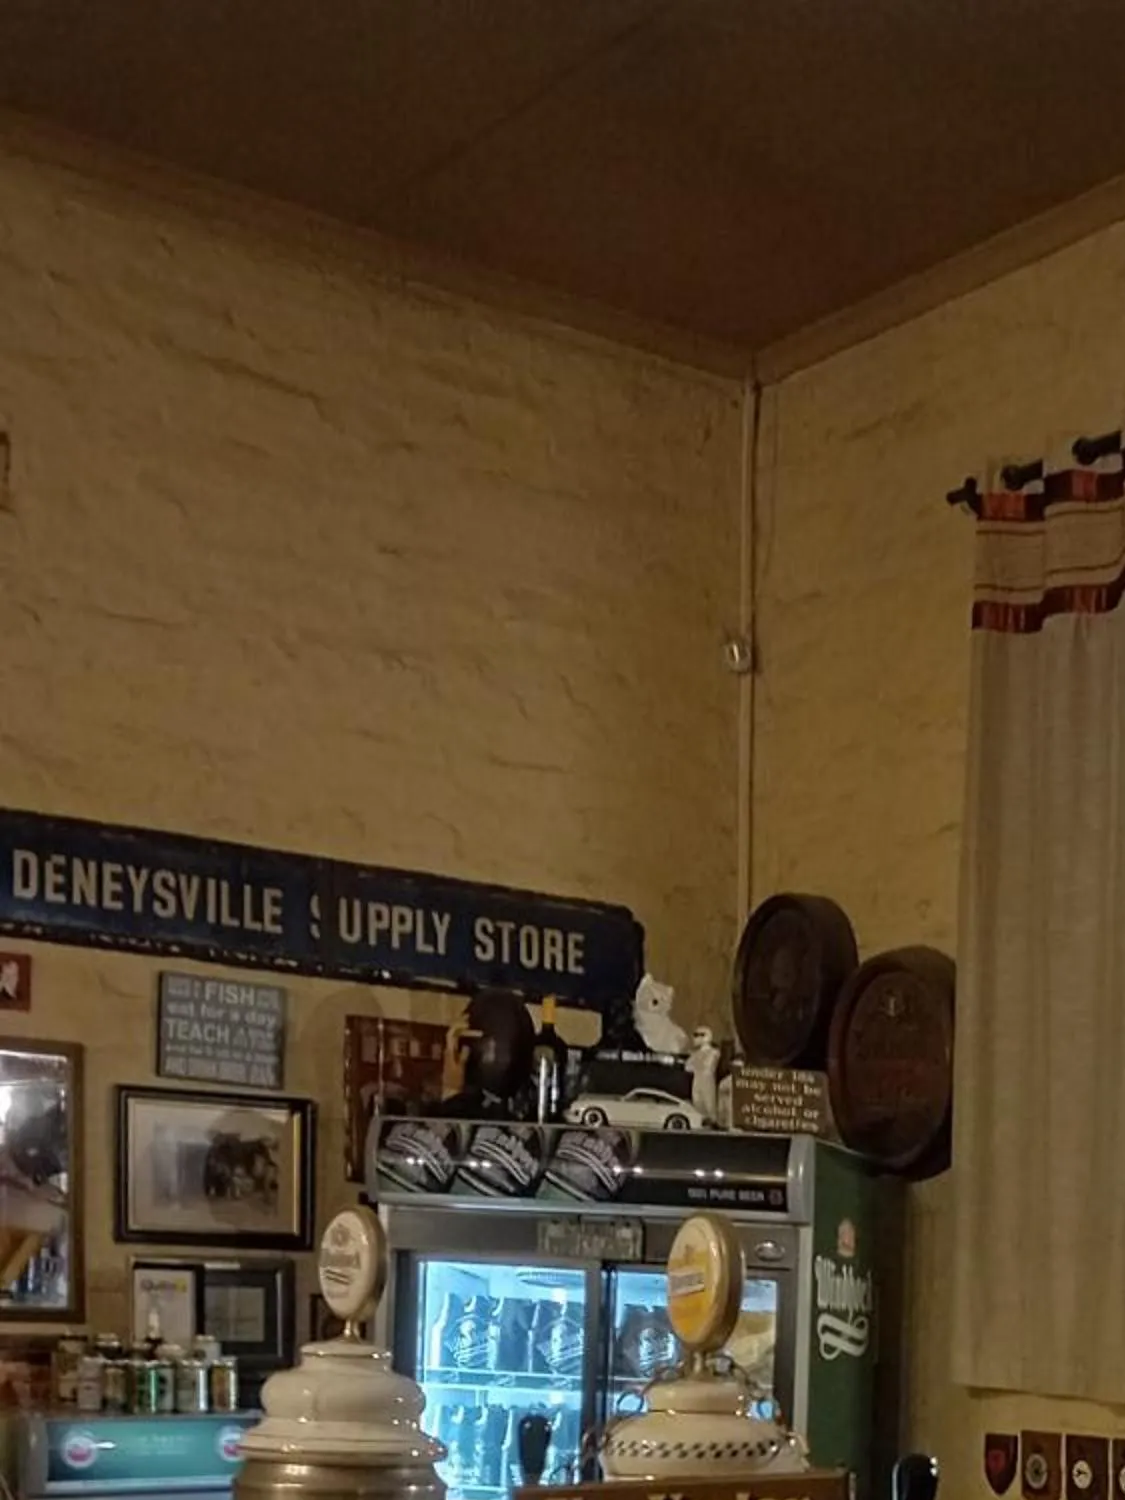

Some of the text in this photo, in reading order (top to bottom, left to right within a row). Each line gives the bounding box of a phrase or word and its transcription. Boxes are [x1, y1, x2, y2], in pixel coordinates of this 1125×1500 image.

[12, 848, 284, 934] DENEYSVILLE
[473, 916, 586, 975] STORE
[204, 981, 256, 1006] FISH
[165, 1017, 230, 1045] TEACH
